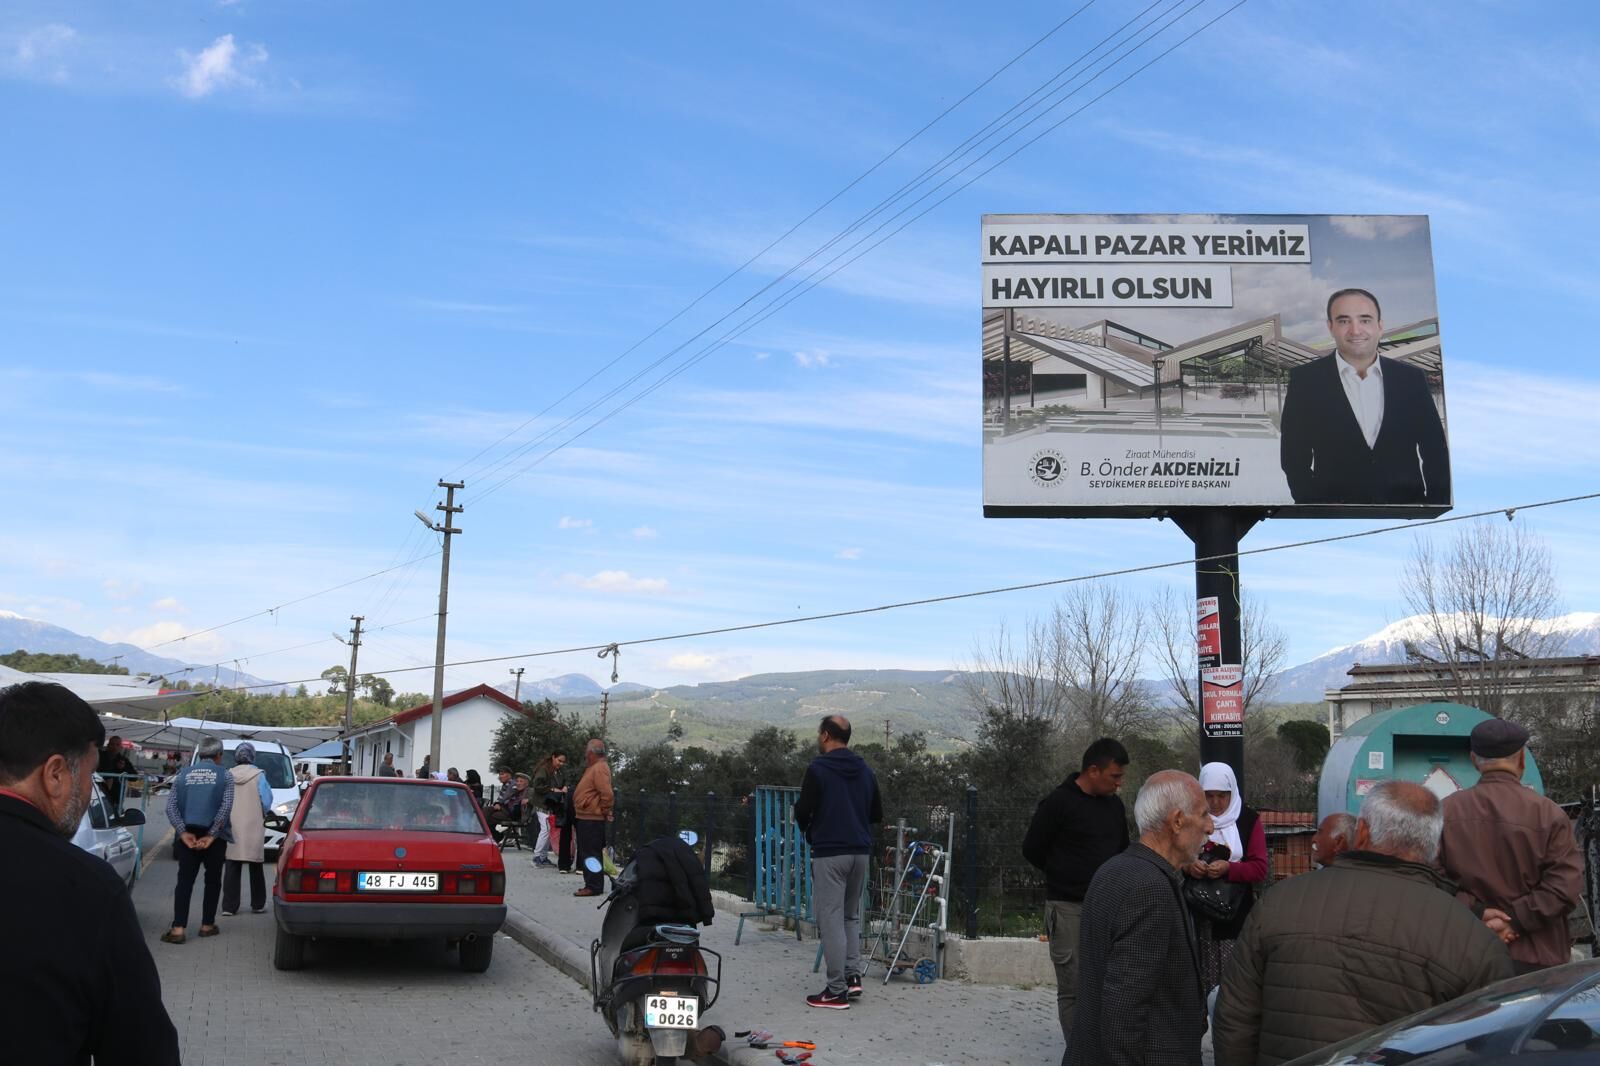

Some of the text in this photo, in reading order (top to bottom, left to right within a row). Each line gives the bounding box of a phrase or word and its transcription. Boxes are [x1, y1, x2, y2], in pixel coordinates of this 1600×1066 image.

[989, 229, 1305, 256] KAPALI PAZAR YERİMİZ
[992, 277, 1212, 300] HAYIRLI OLSUN
[1125, 450, 1196, 459] Ziraat Mühendisi
[1080, 458, 1240, 476] B. Önder AKDENİZLİ
[1089, 478, 1231, 490] SEYDİKEMER BELEDİYE BAŞKANI
[366, 875, 382, 887] 48
[389, 875, 405, 887] FJ
[412, 875, 436, 888] 445
[650, 998, 686, 1010] 48 H
[659, 1013, 694, 1026] 0026
